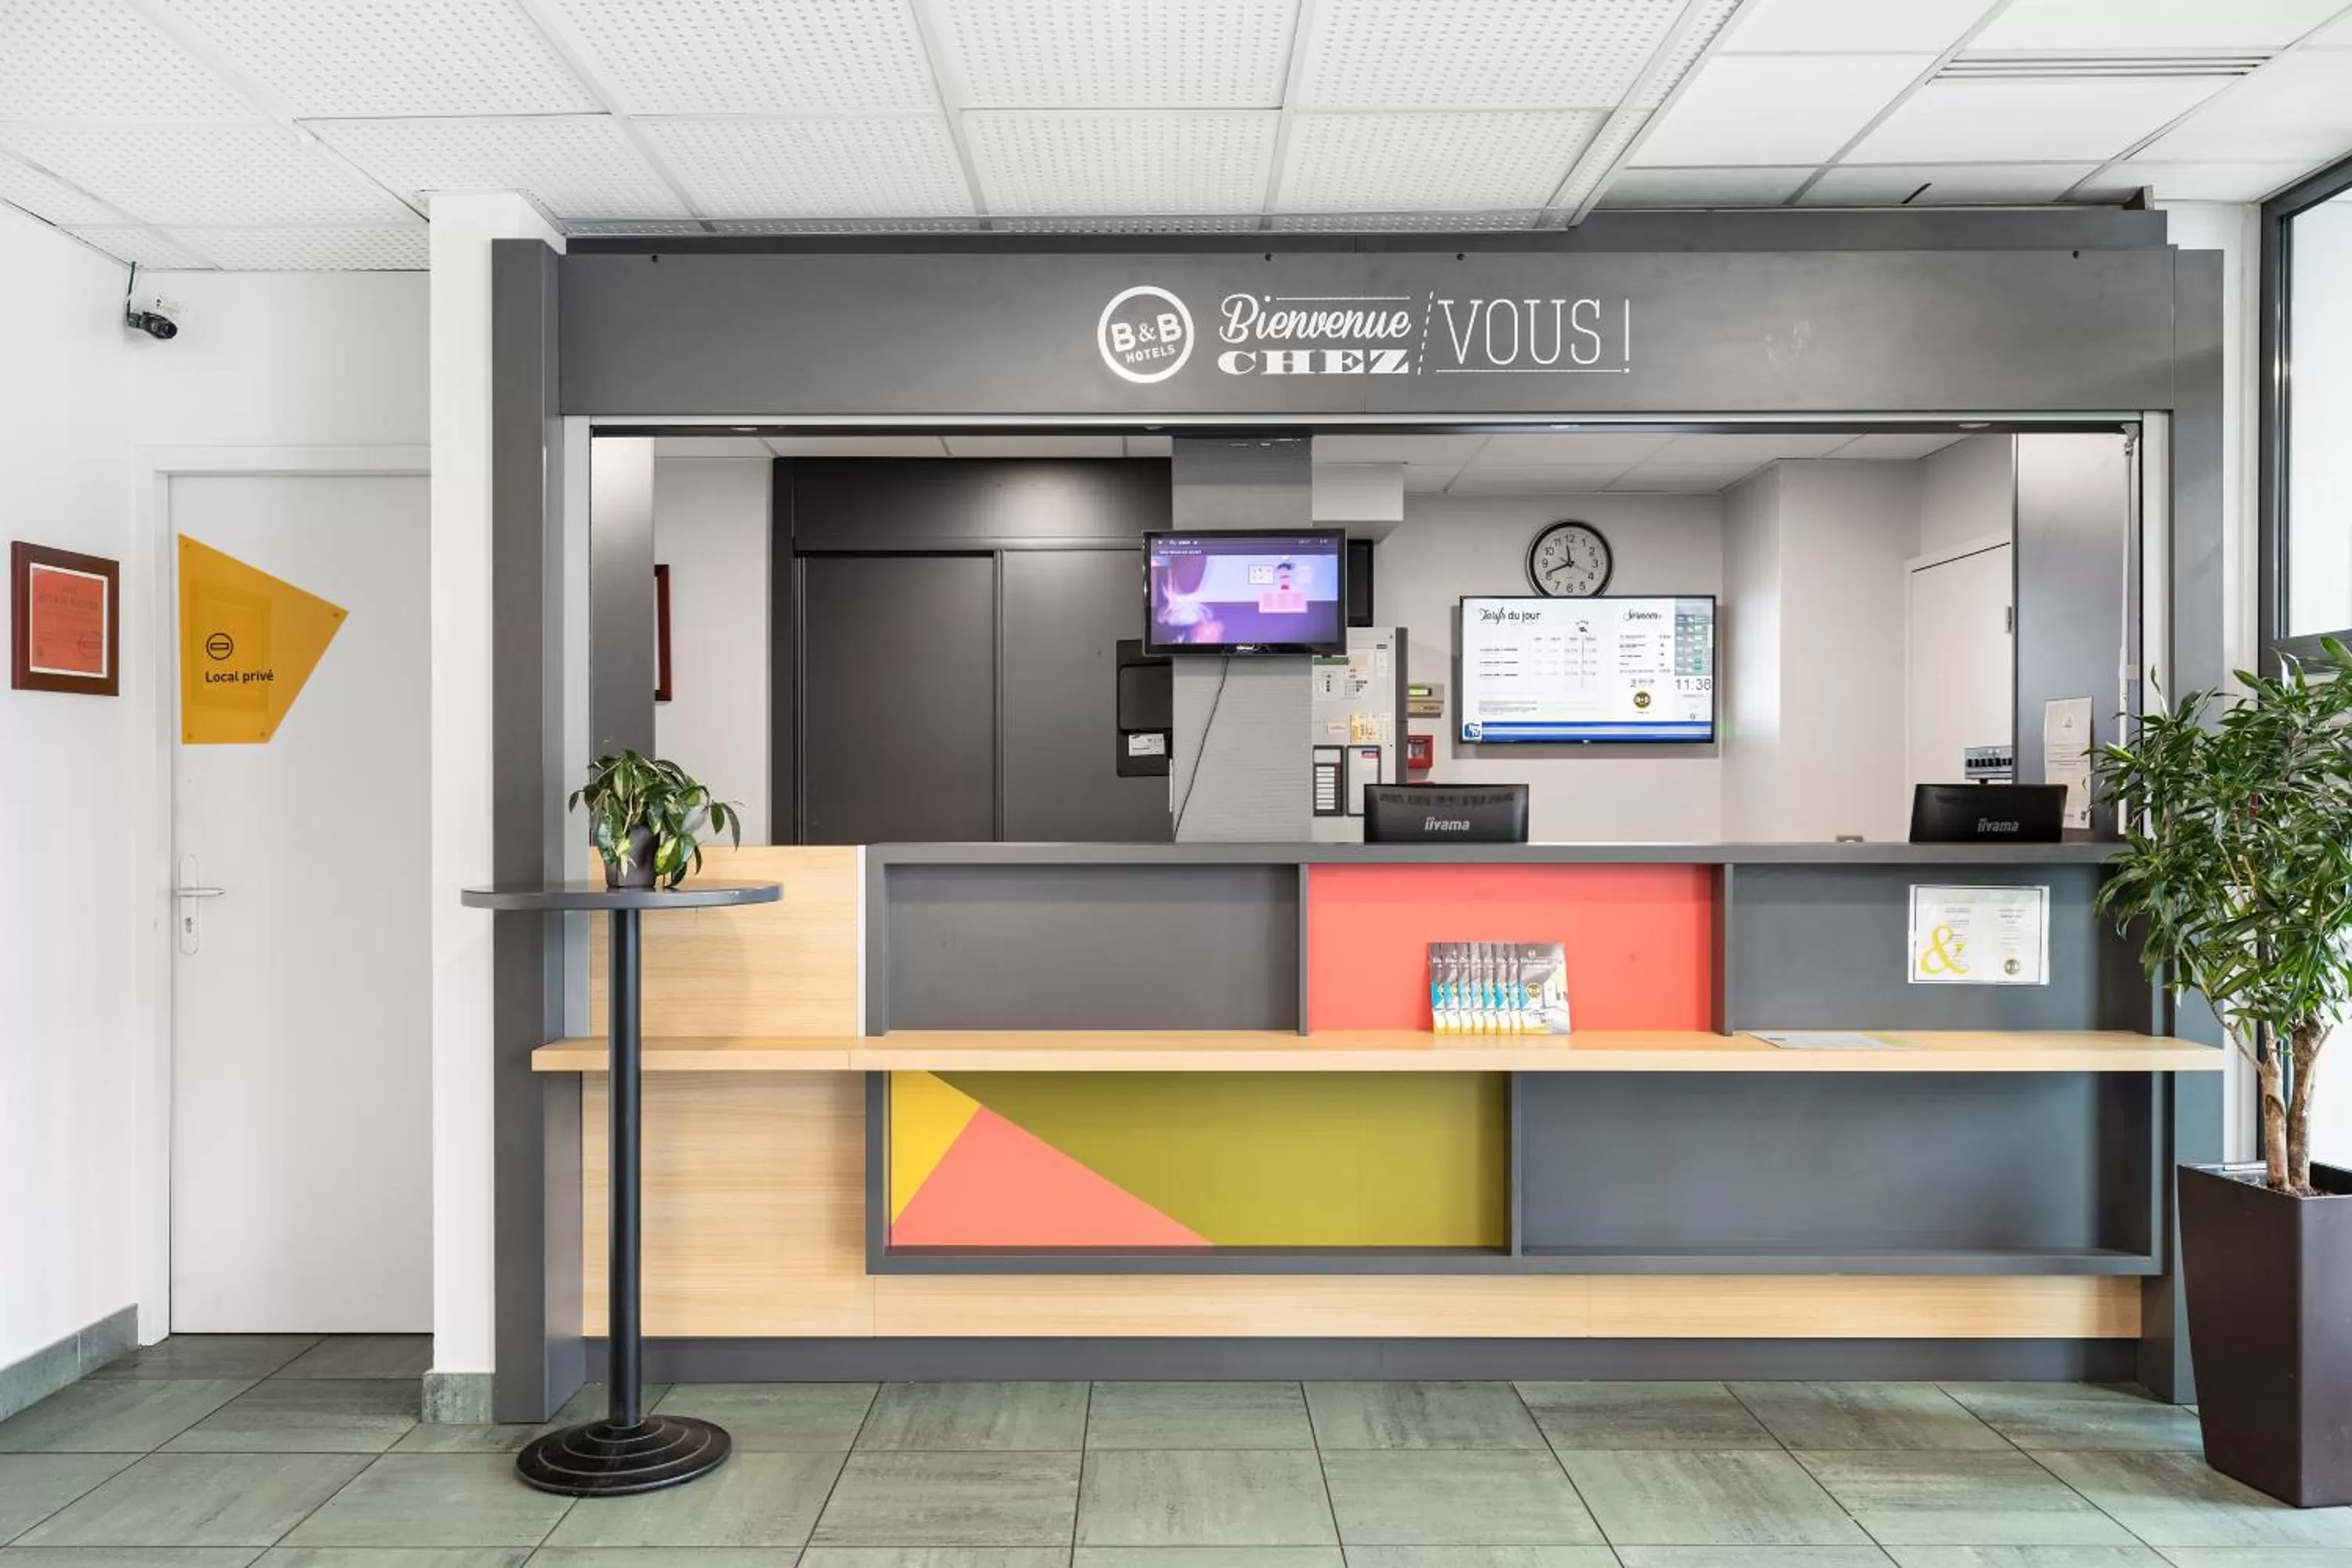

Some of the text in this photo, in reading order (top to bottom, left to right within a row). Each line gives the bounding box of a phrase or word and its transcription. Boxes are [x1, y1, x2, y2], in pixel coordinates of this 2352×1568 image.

[1219, 293, 1411, 343] Bienvenue
[1111, 313, 1182, 353] B&B
[1437, 299, 1600, 365] VOUS
[1125, 344, 1176, 364] HOTELS
[1218, 349, 1409, 376] CHEZ
[1555, 581, 1561, 590] 7
[1566, 583, 1573, 593] 6
[1579, 581, 1586, 591] 5
[1508, 610, 1520, 620] du
[1522, 612, 1541, 623] jour
[205, 669, 274, 684] Local privé
[1675, 678, 1711, 691] 11:38
